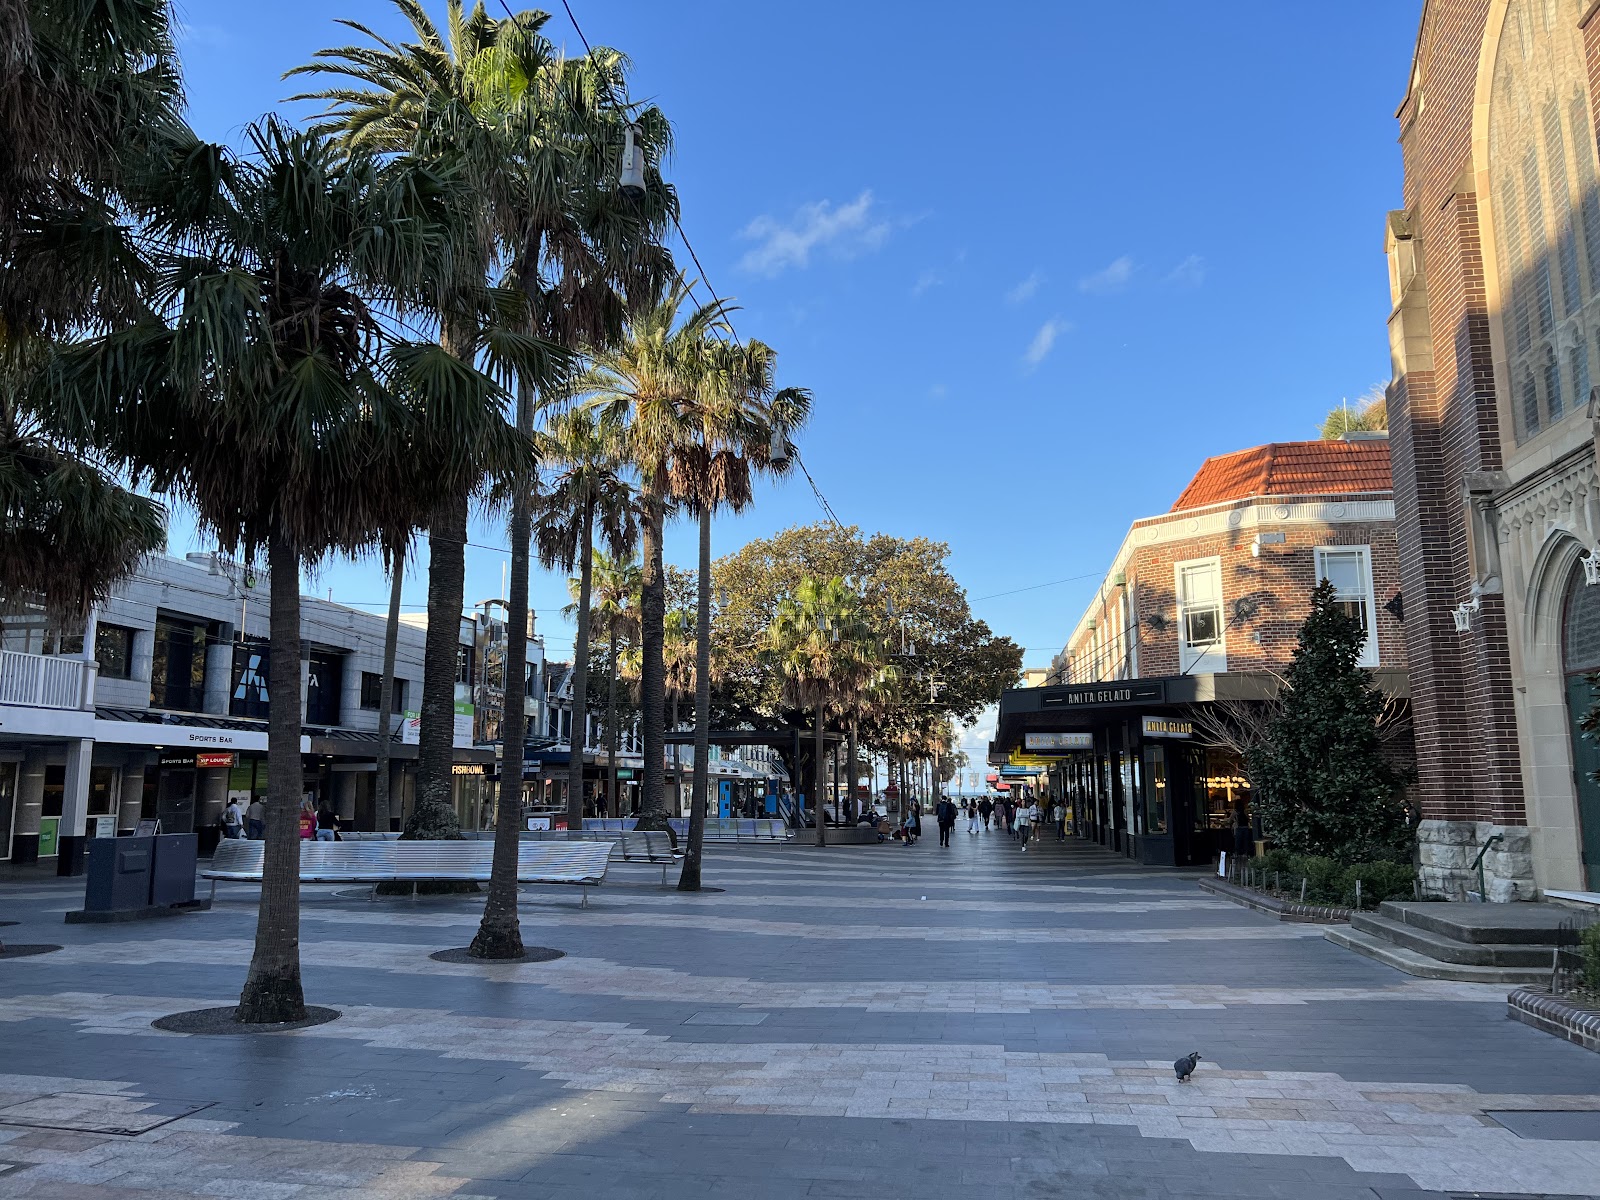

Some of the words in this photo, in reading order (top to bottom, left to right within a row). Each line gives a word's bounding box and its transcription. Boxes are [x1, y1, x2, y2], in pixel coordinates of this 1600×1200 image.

[1068, 691, 1094, 705] ANITA
[1097, 689, 1131, 702] GELATO
[1146, 721, 1168, 732] ANITA
[1168, 722, 1192, 734] GELATO
[189, 733, 217, 743] SPORTS
[219, 736, 233, 744] BAR
[1029, 736, 1055, 746] ANITA
[1059, 736, 1090, 746] GELATO
[451, 764, 485, 775] FISHBOWL
